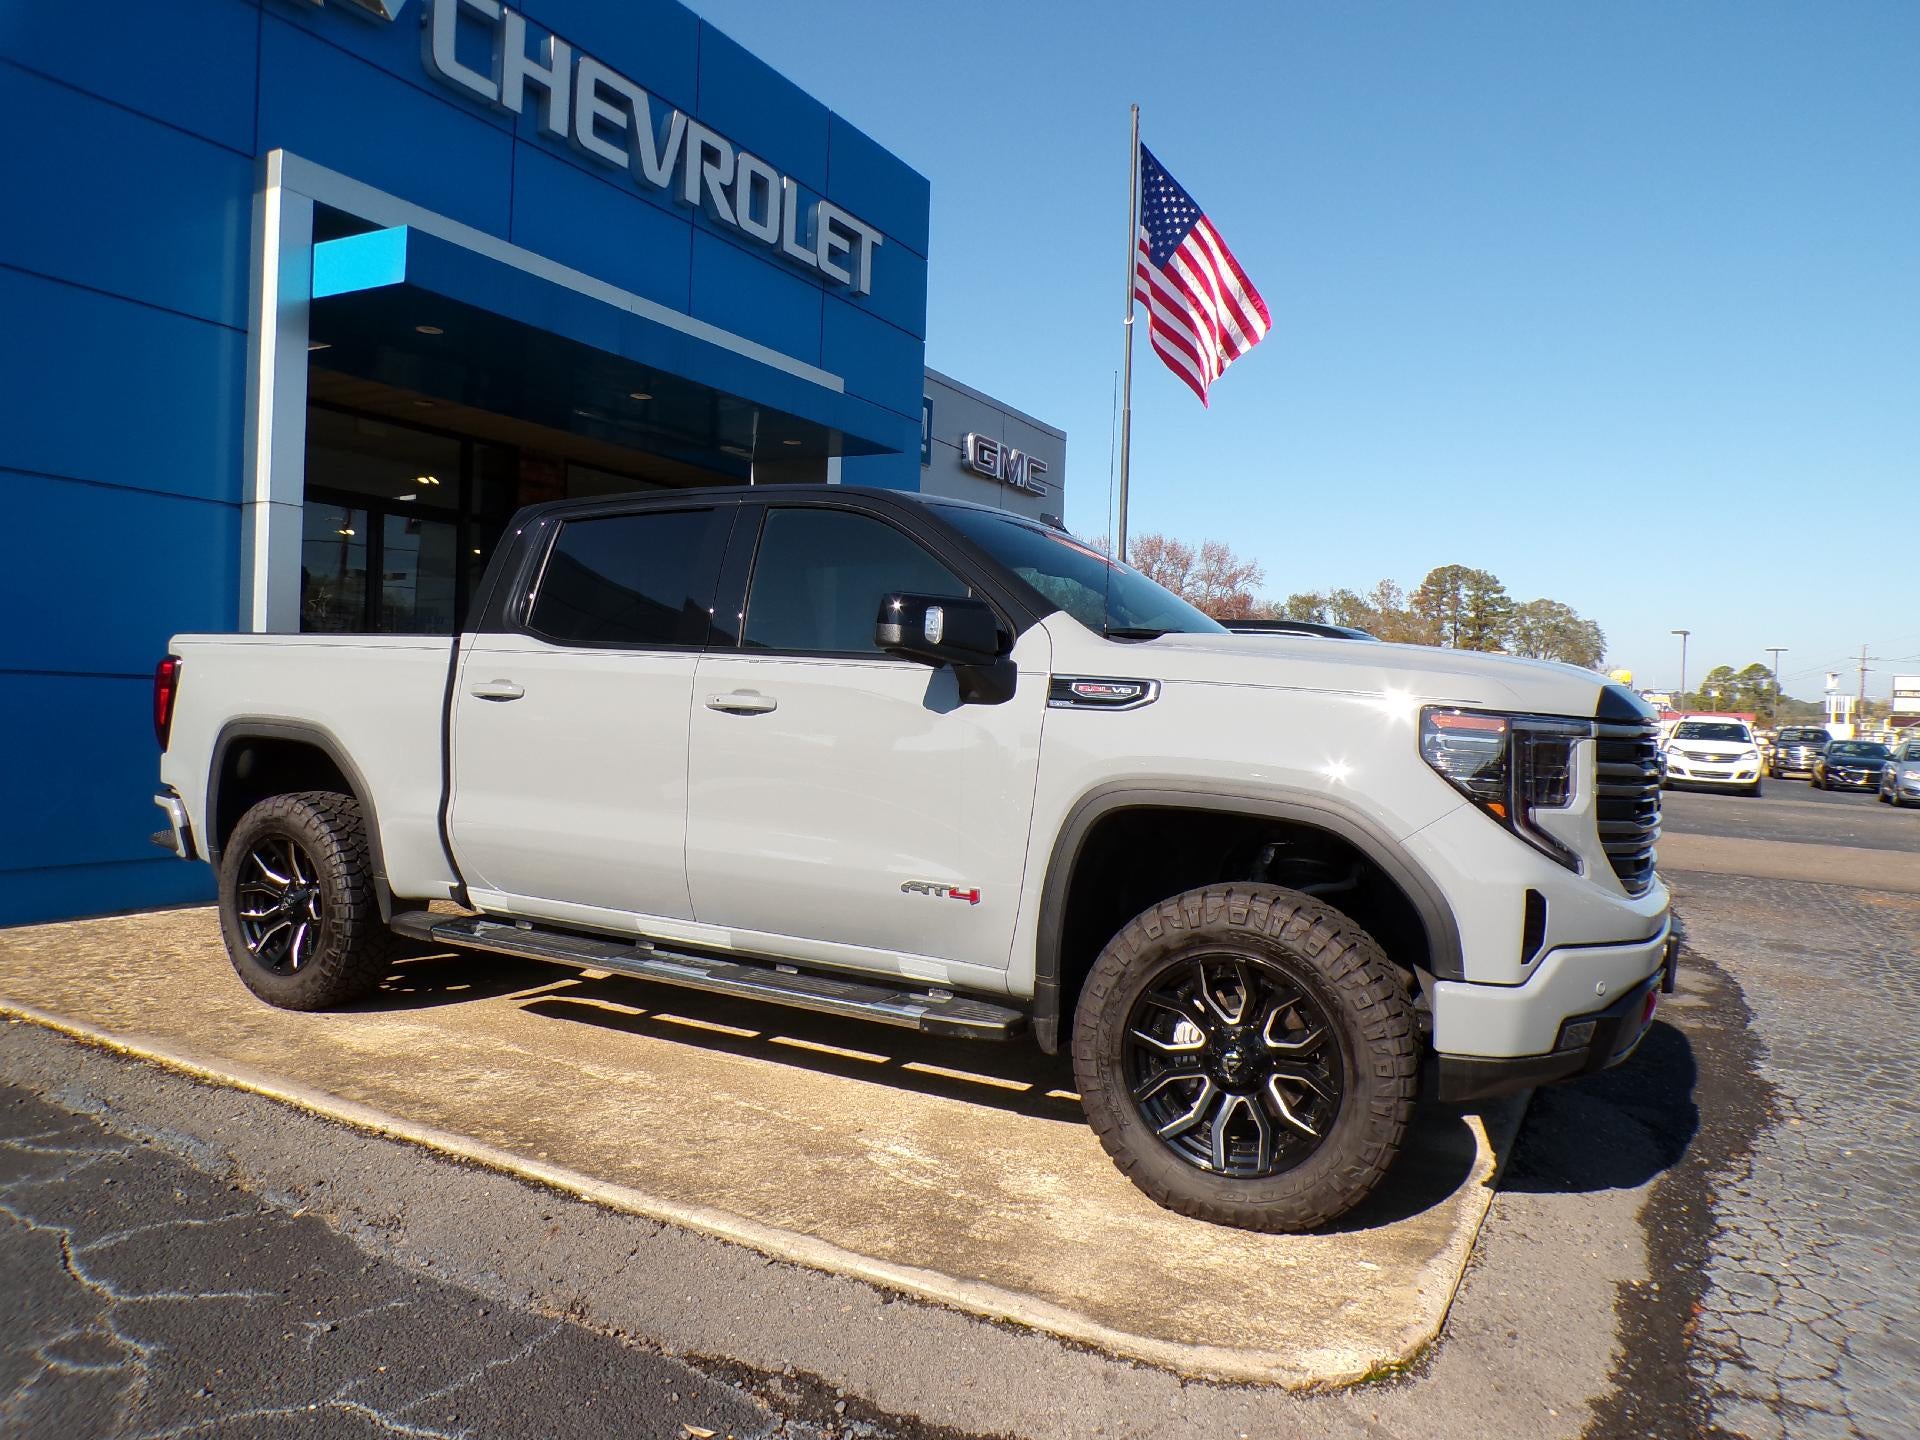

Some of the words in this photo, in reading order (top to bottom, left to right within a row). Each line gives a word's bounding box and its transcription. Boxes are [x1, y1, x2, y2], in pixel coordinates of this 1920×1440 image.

[421, 0, 883, 297] CHEVROLET
[964, 432, 1048, 497] GMC
[901, 879, 980, 905] AT4
